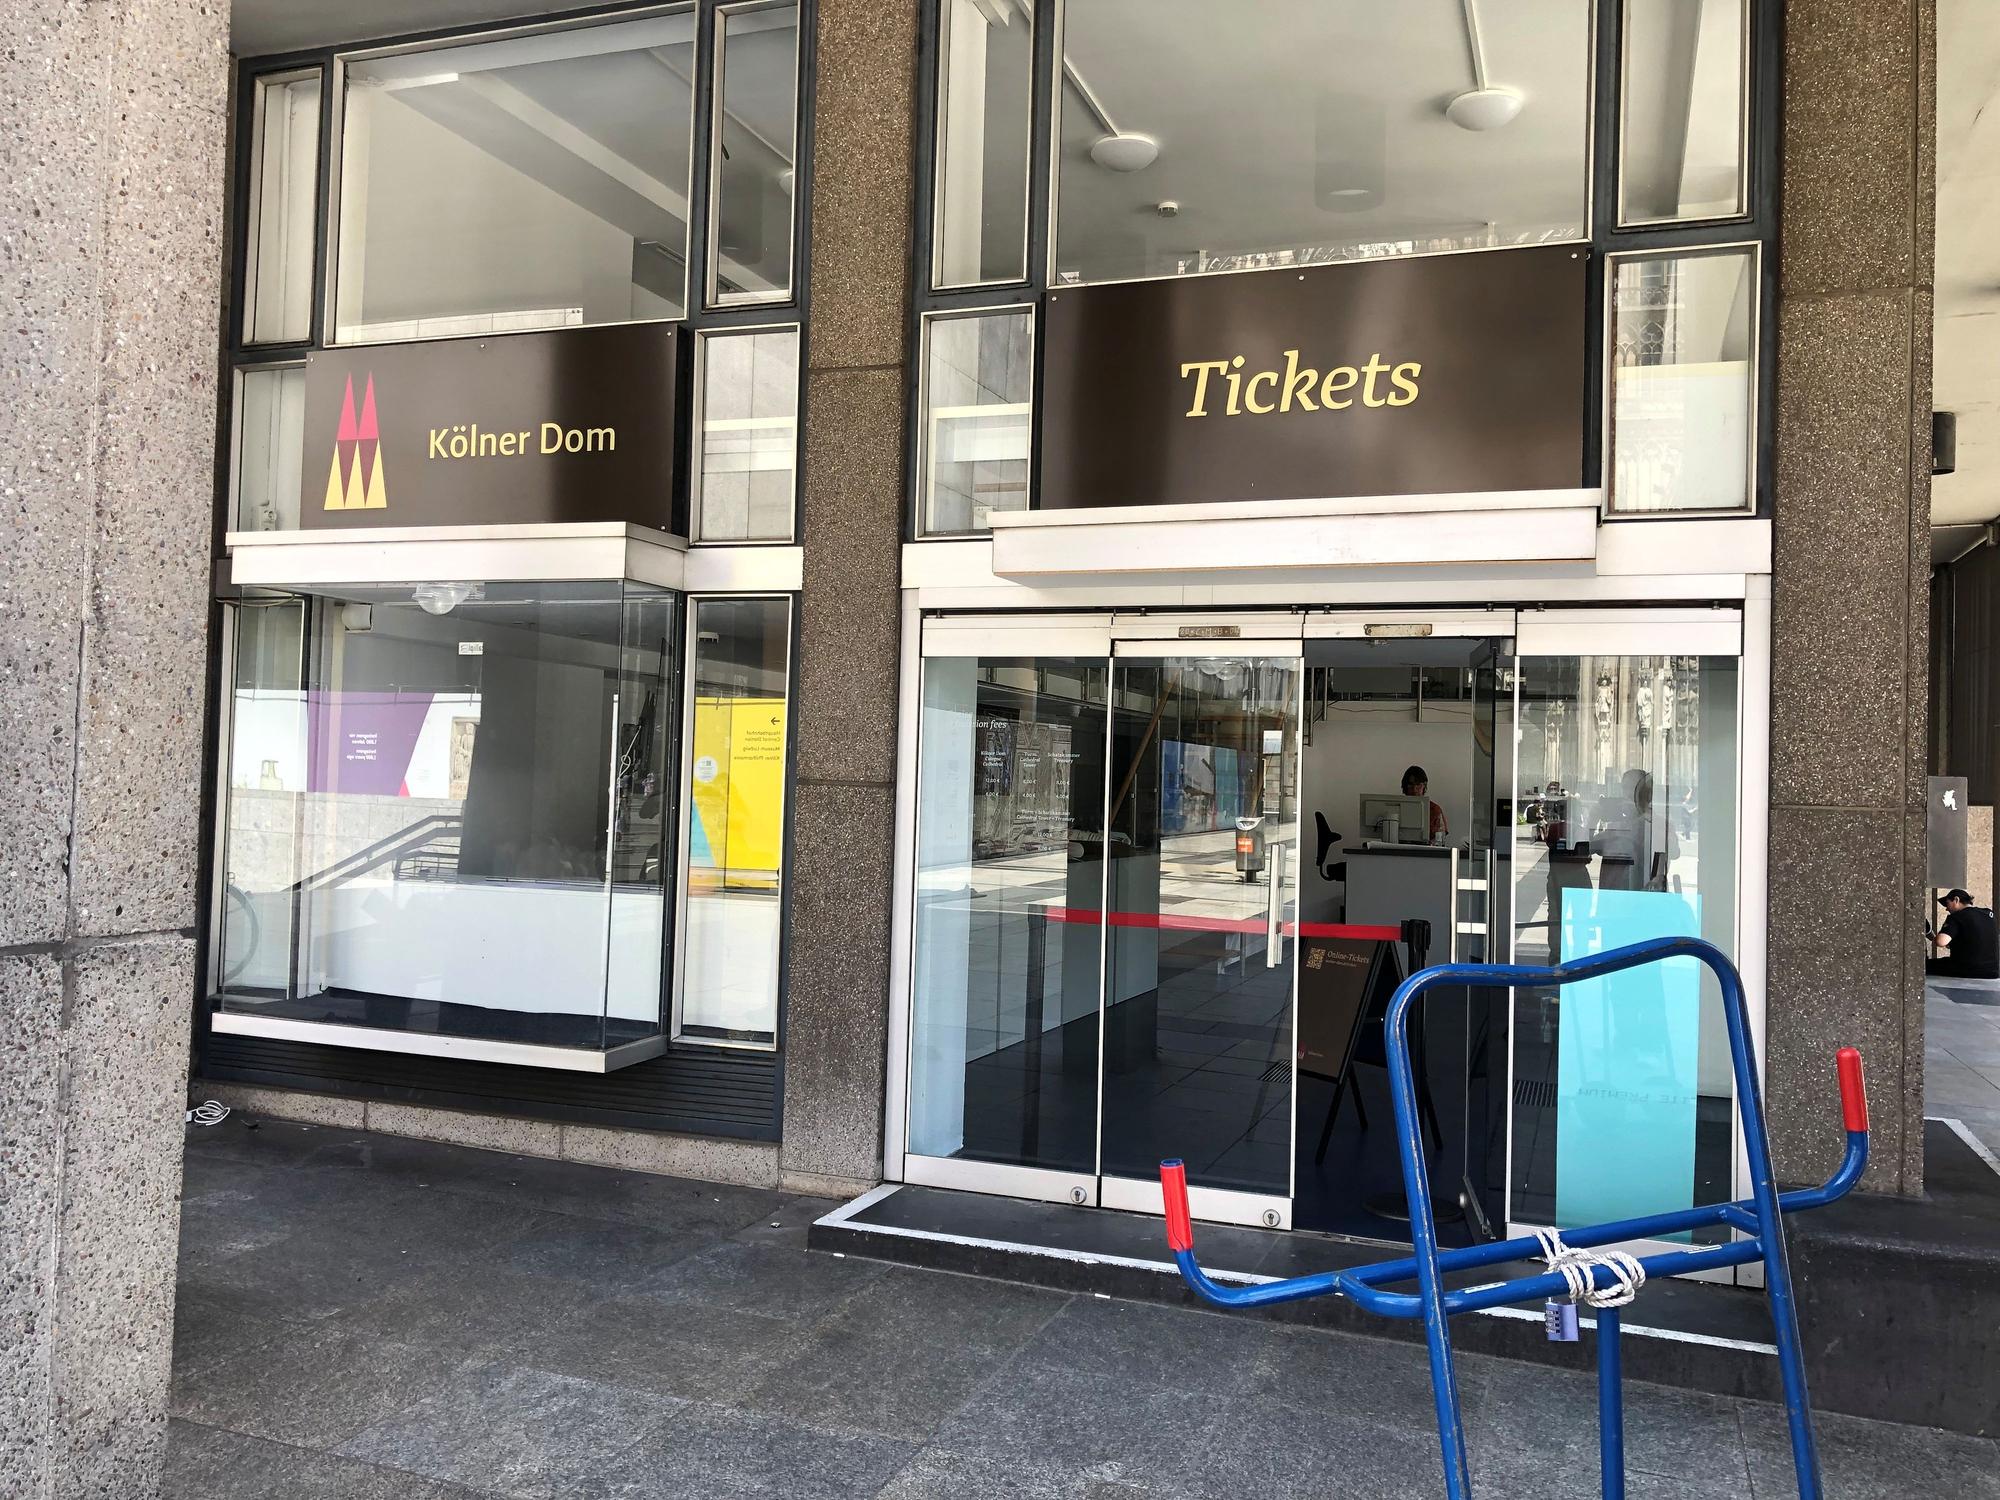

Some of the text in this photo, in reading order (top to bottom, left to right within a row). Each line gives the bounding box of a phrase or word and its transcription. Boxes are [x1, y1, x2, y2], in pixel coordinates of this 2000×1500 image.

[1181, 350, 1422, 418] Tickets
[429, 423, 616, 459] Kölner Dom
[990, 720, 1007, 730] fees
[1327, 951, 1370, 964] Online-Tickets
